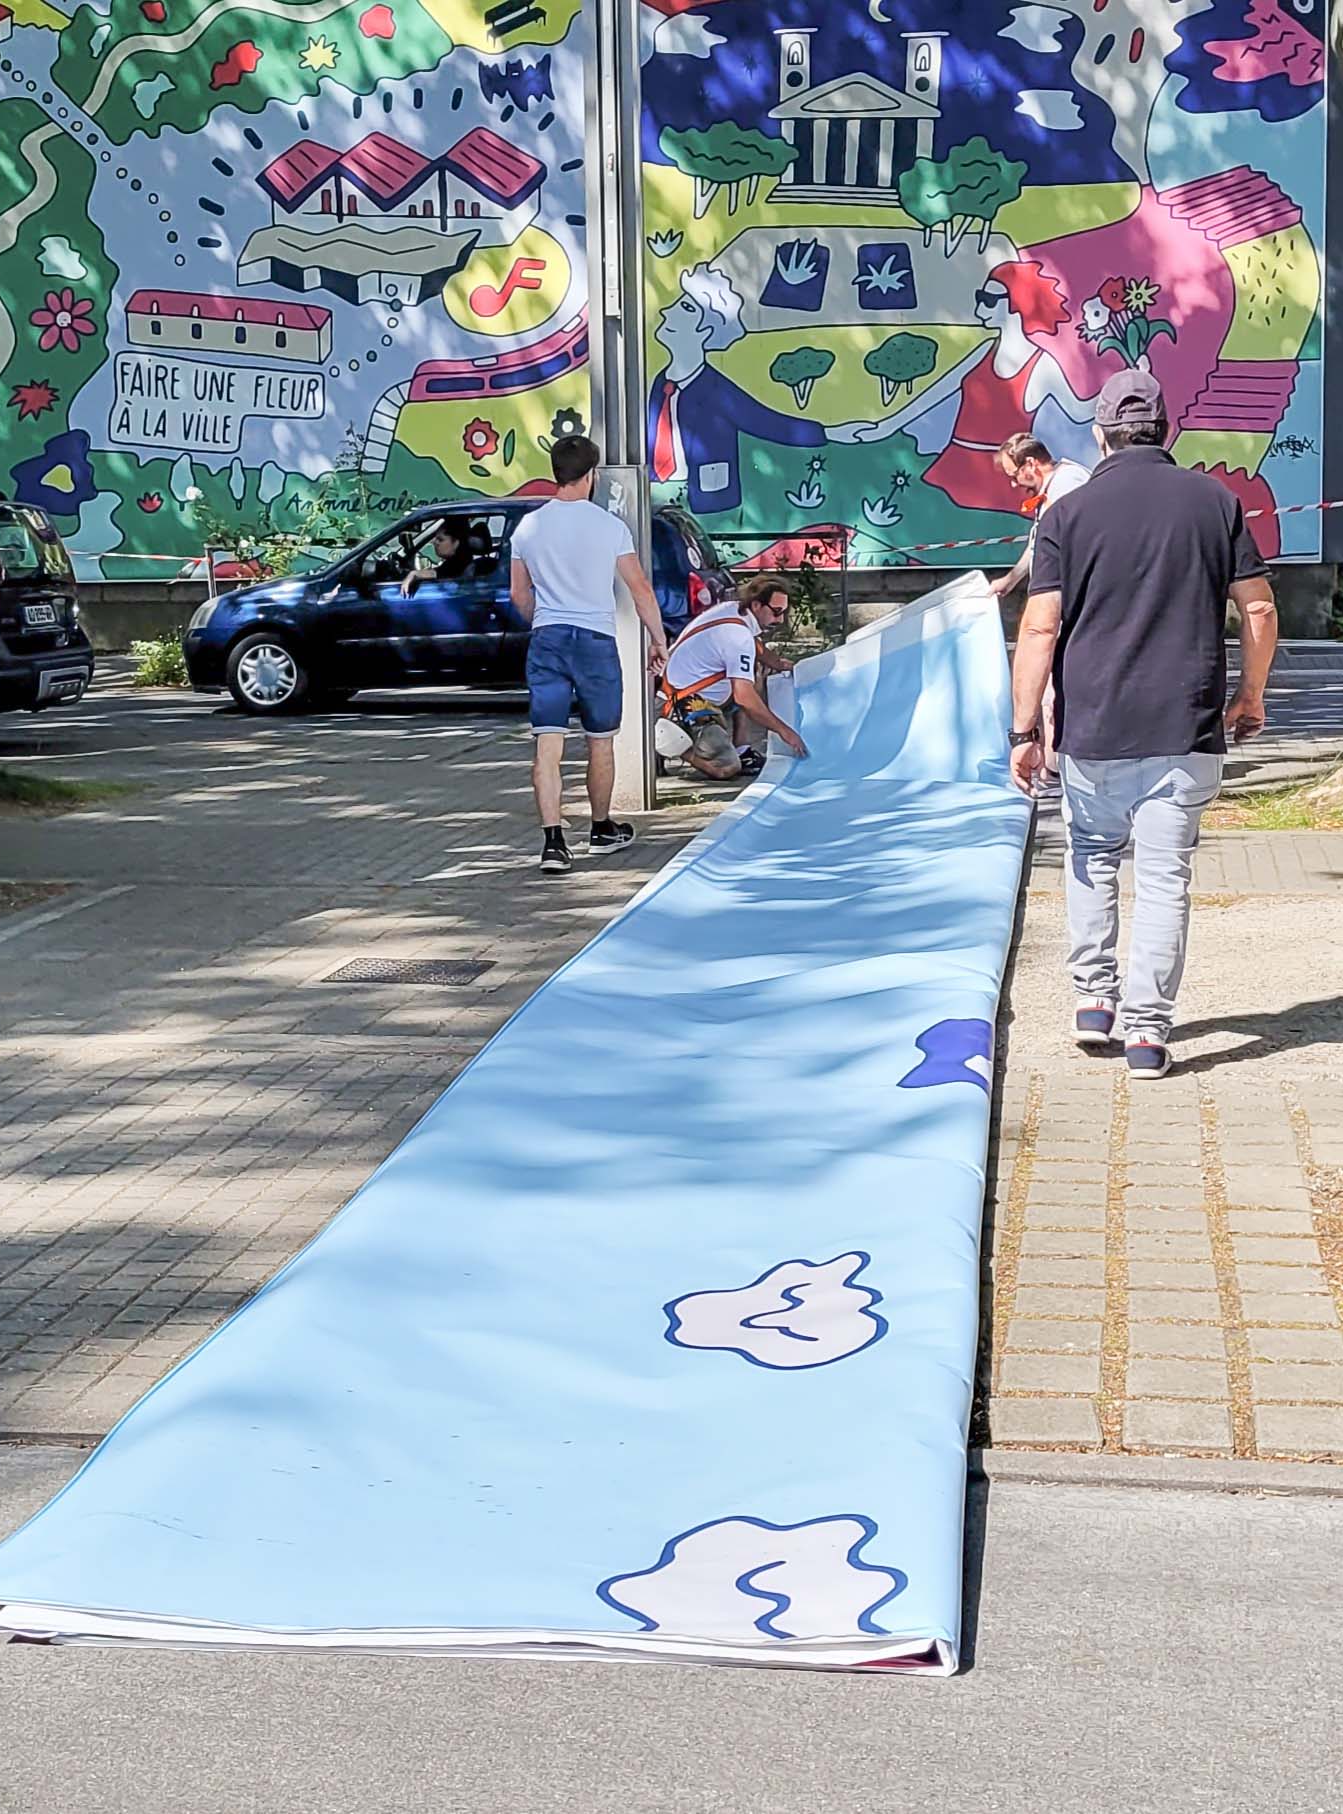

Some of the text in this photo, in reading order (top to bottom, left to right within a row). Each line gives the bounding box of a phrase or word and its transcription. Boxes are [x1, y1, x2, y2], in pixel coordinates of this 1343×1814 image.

[194, 368, 236, 402] UNE
[253, 375, 320, 412] FLEUR
[117, 400, 133, 434] À
[143, 408, 167, 438] LA
[740, 654, 750, 672] 5
